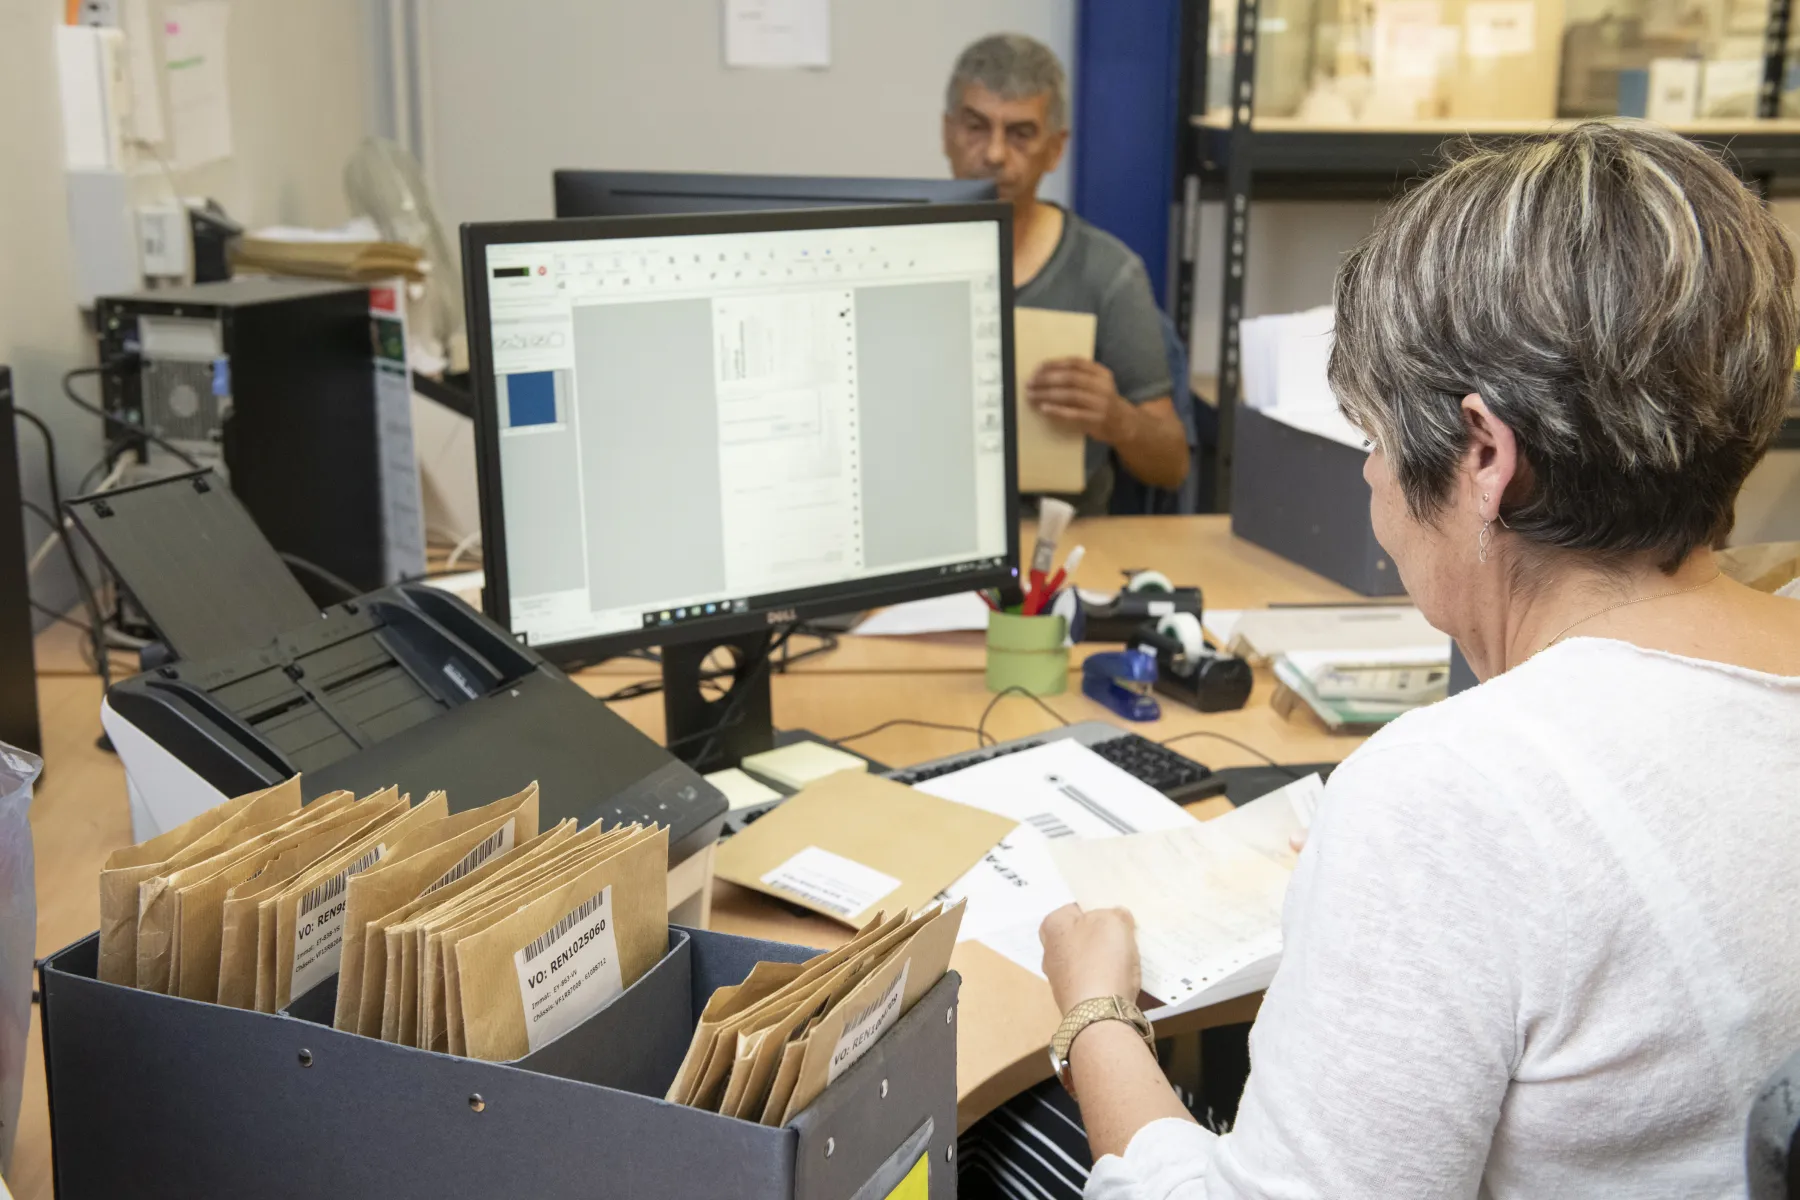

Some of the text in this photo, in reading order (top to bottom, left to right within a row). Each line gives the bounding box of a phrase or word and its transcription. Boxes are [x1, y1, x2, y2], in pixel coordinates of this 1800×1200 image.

[298, 922, 315, 941] VO:
[528, 919, 606, 989] VO: REN1025060
[531, 990, 552, 1010] Immat:
